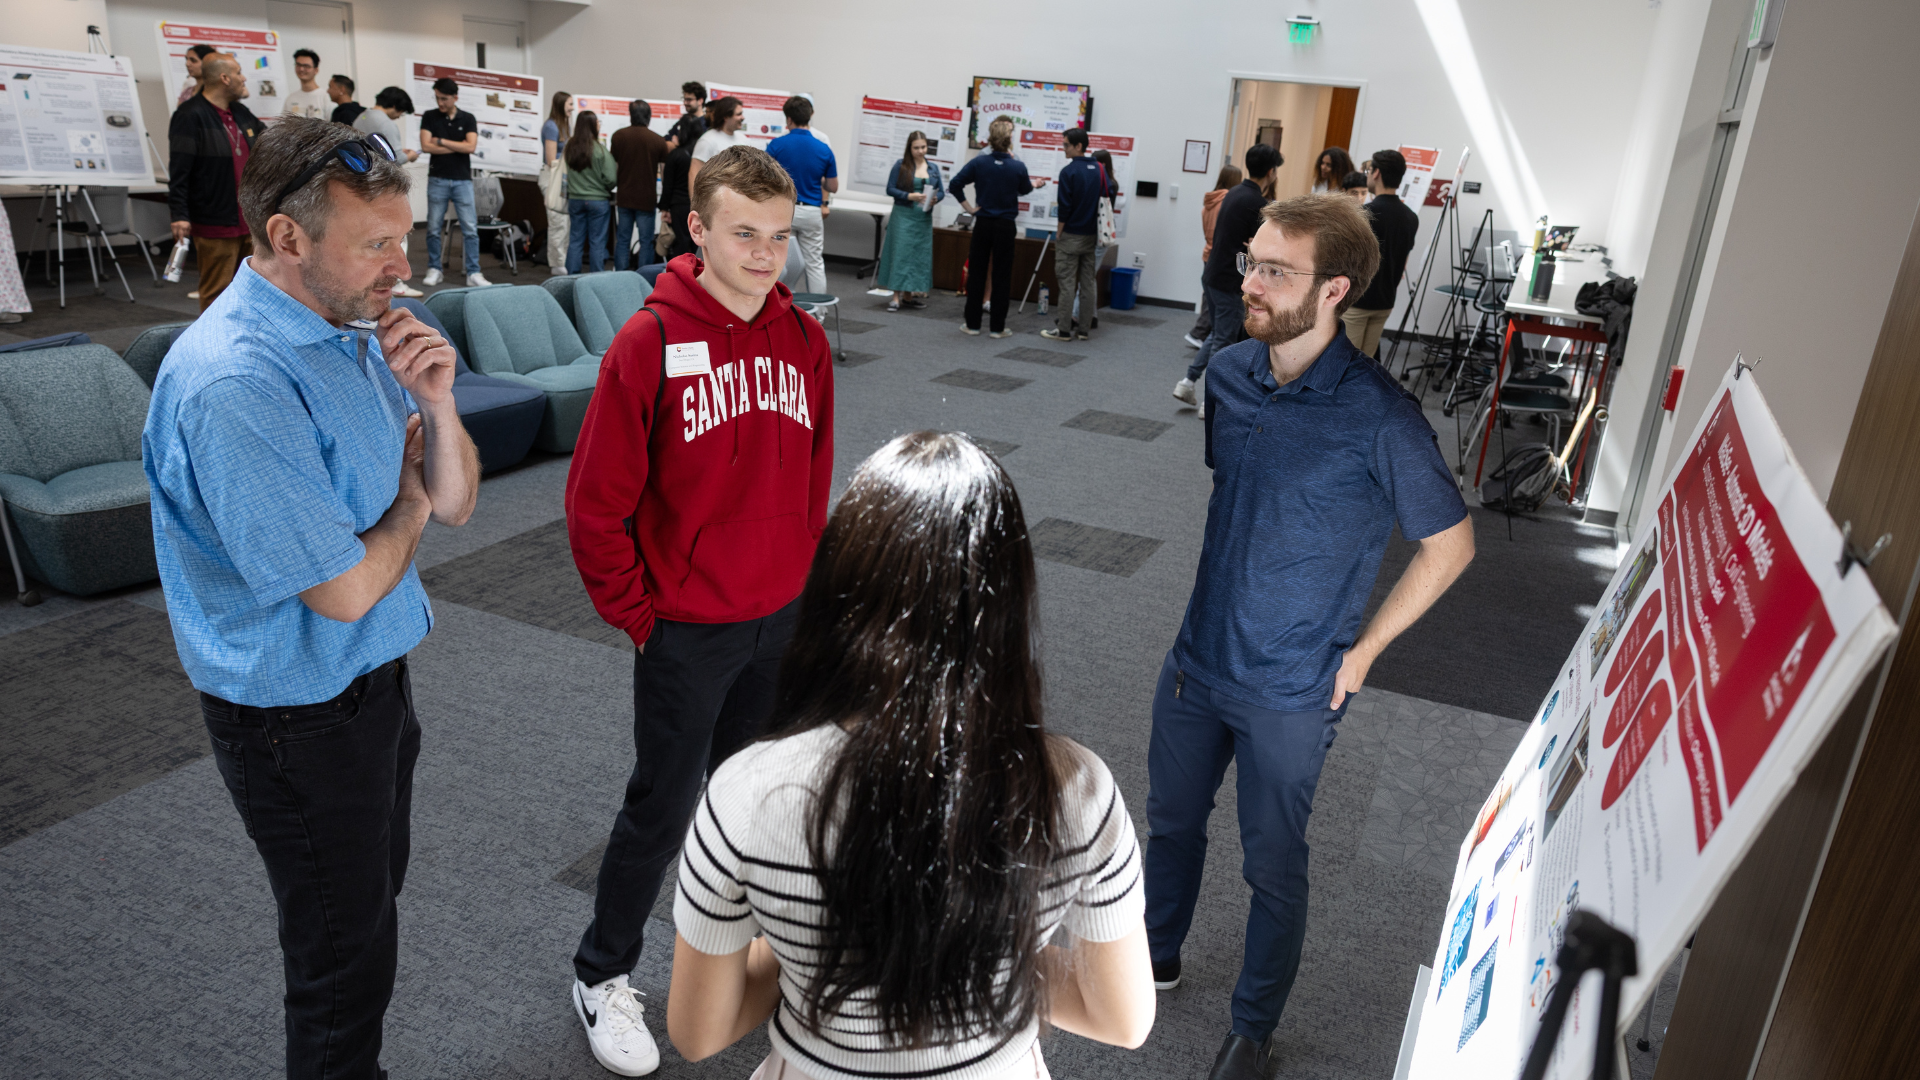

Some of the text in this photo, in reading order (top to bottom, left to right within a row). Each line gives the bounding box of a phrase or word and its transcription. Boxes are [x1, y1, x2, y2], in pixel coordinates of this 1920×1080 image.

[1289, 24, 1314, 44] EXIT
[983, 102, 1022, 114] COLORES
[1008, 116, 1032, 128] ERRA
[683, 356, 813, 442] SANTA CLARA
[1725, 464, 1748, 522] Automatic
[1737, 504, 1756, 536] 3D
[1745, 519, 1775, 581] Models
[1725, 554, 1743, 583] Civil
[1733, 570, 1756, 639] Engineering
